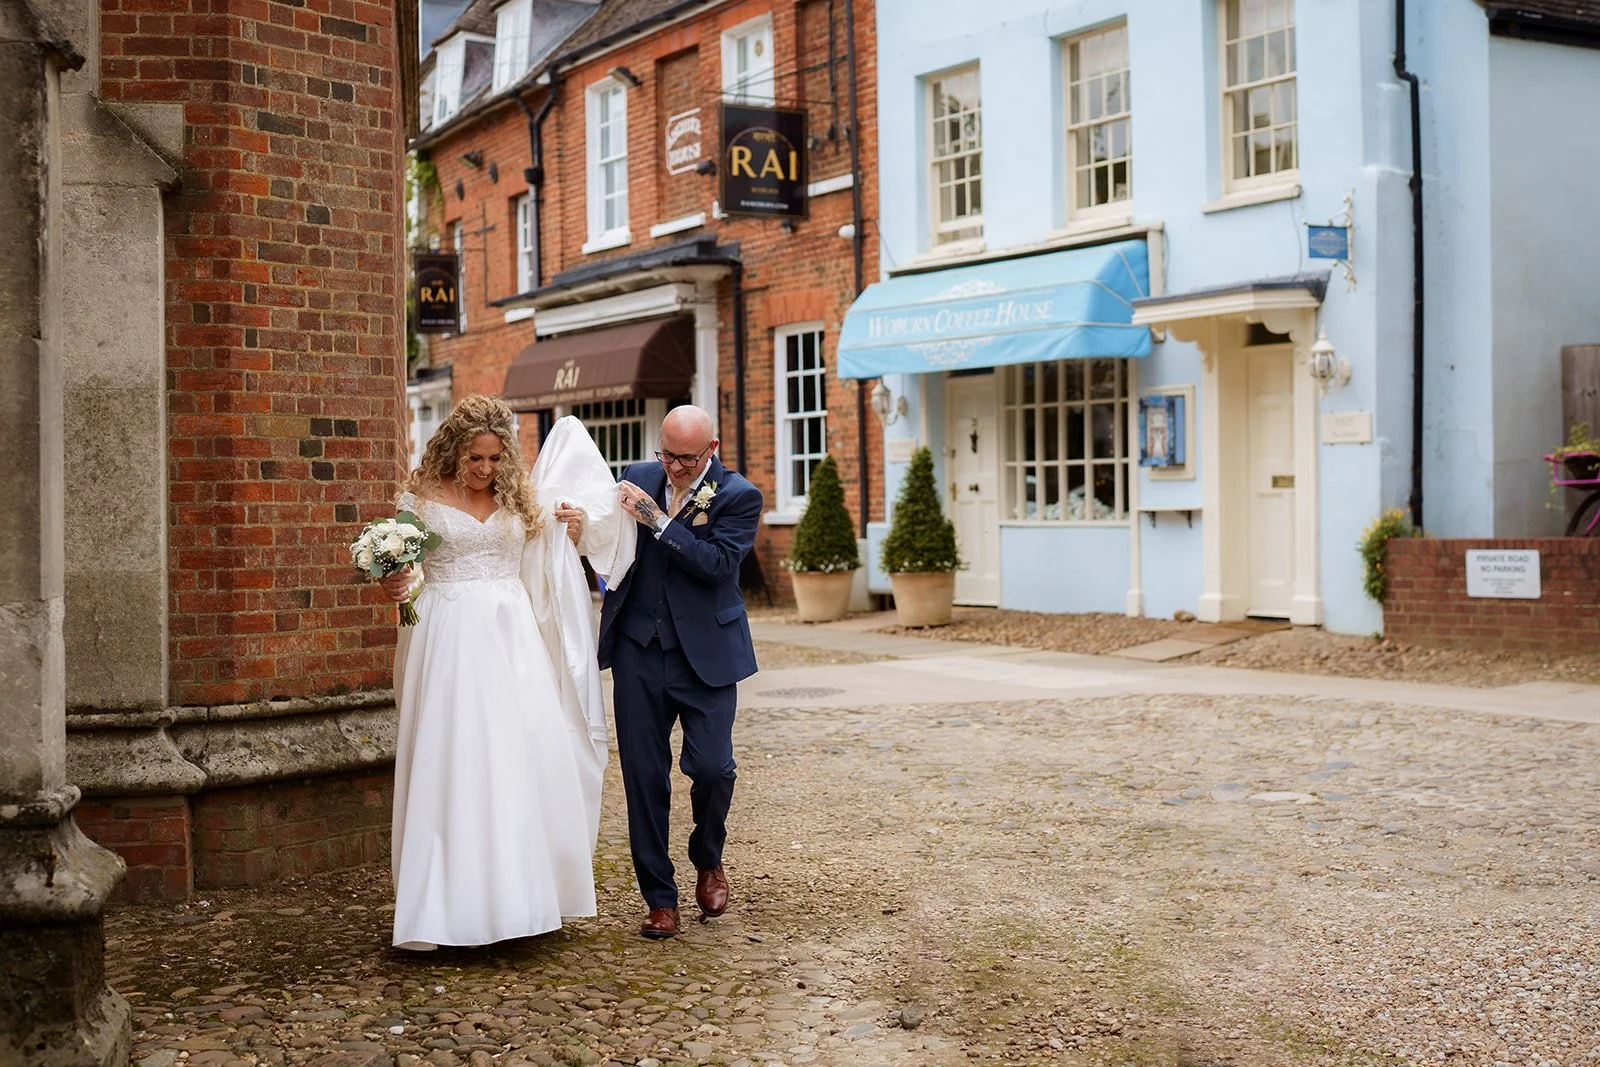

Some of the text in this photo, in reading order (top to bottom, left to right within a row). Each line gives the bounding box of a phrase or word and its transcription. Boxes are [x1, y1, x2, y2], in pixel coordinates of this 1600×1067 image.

[731, 145, 798, 181] RAI
[420, 286, 455, 303] RAI
[868, 299, 1054, 339] WOBURN COFFEE HOUSE
[553, 366, 580, 391] RAI
[1476, 554, 1529, 562] PRIVATE ROAD
[1481, 565, 1526, 573] NO PARKING
